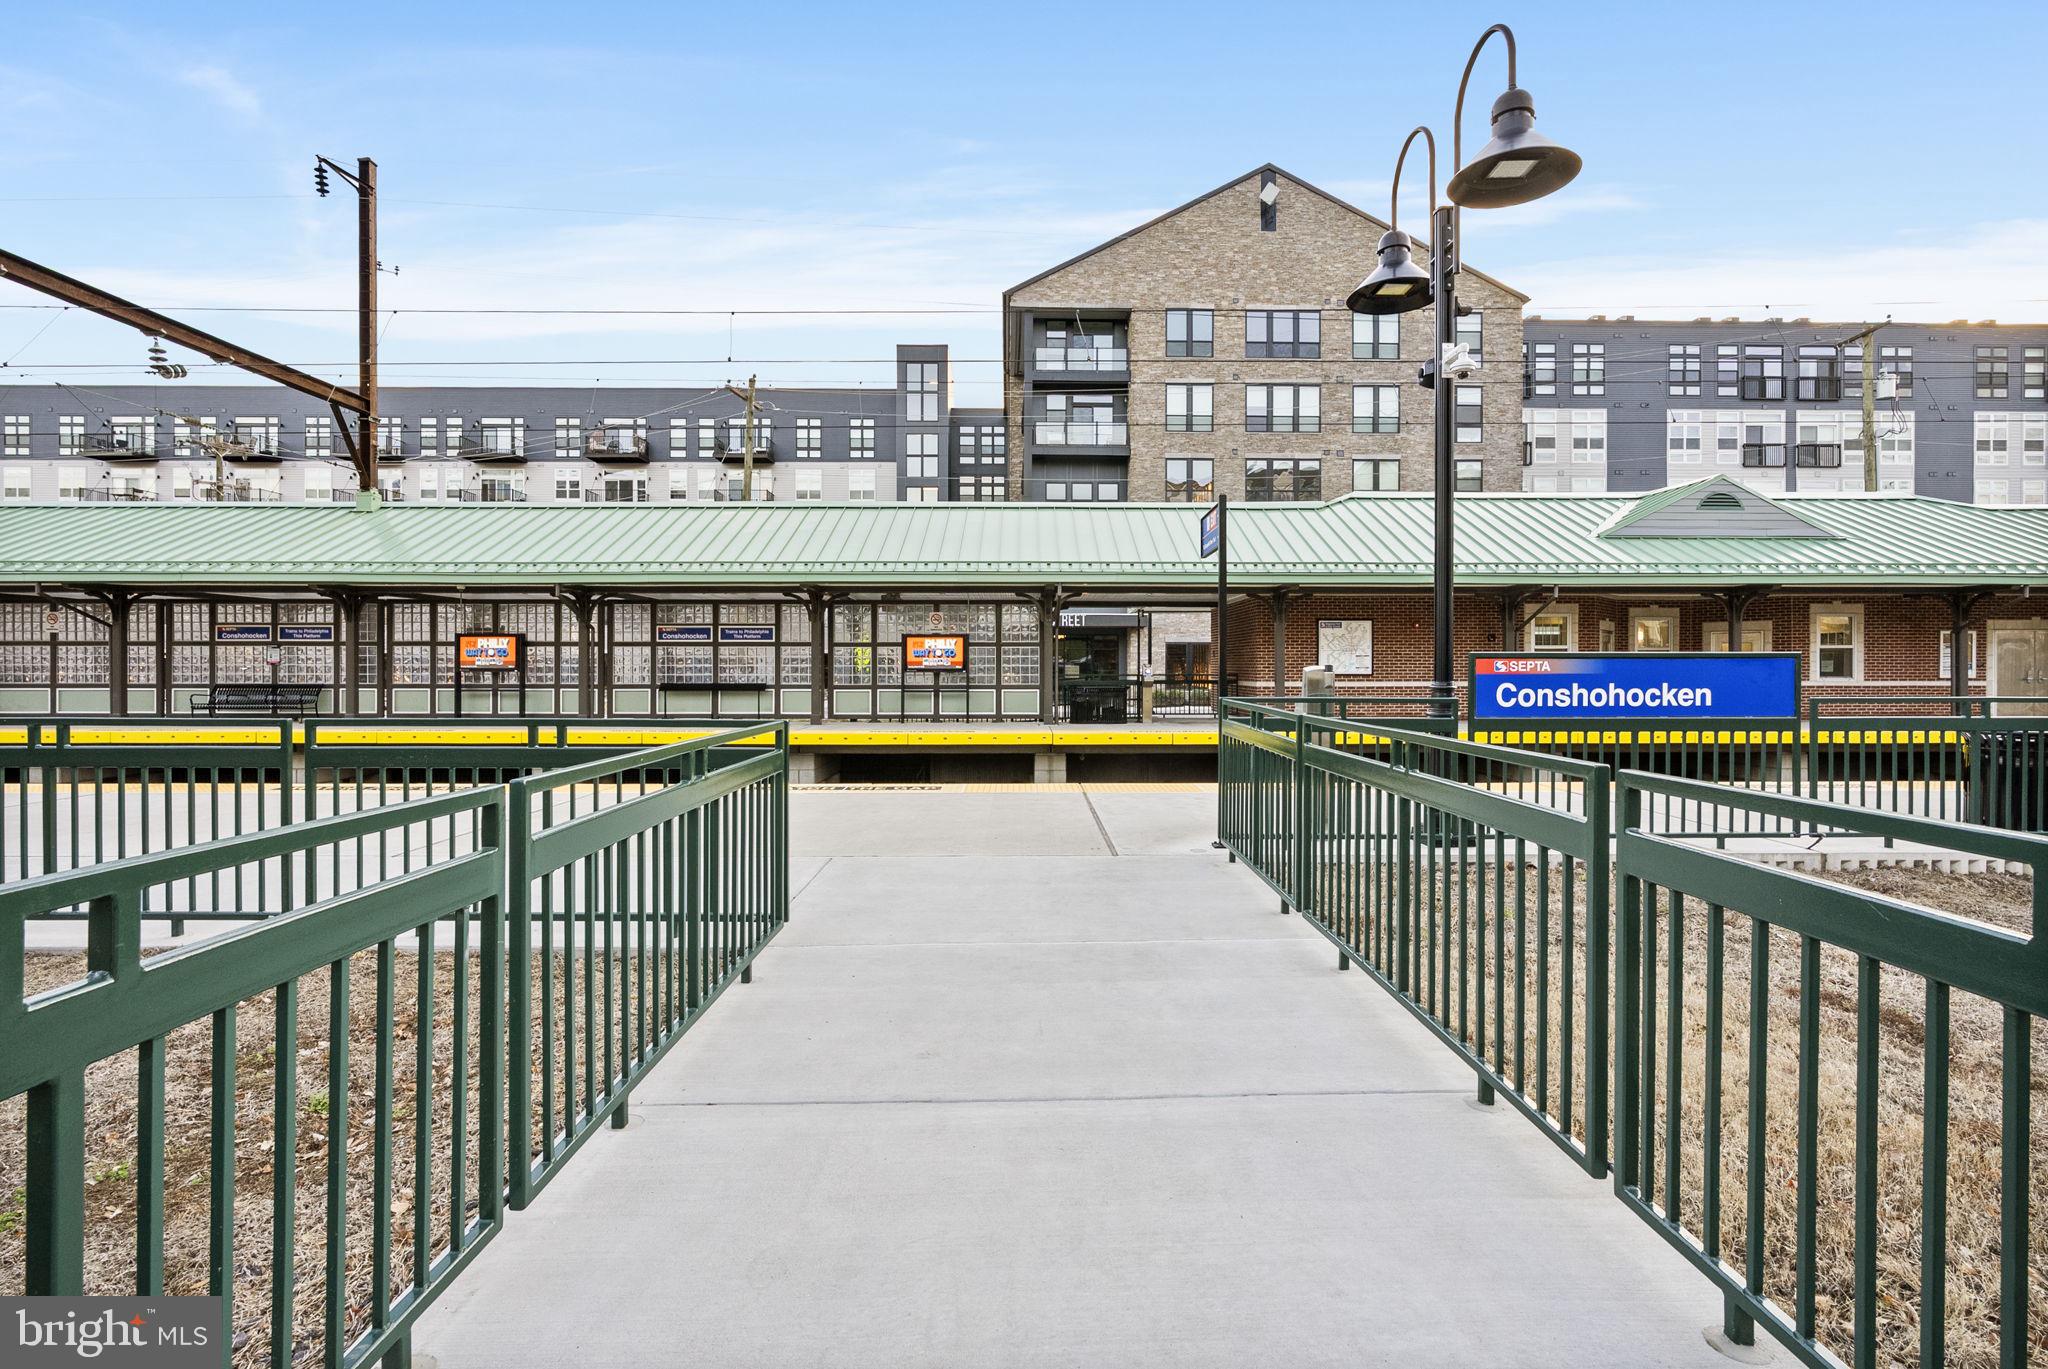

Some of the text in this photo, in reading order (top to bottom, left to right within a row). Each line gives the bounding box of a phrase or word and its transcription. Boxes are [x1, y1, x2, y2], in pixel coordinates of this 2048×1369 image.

[477, 638, 510, 648] PHILLY
[924, 639, 957, 649] PHILLY
[912, 648, 931, 658] WAY
[944, 648, 957, 658] GO
[1509, 661, 1551, 672] SEPTA
[1495, 682, 1712, 707] Conshohocken
